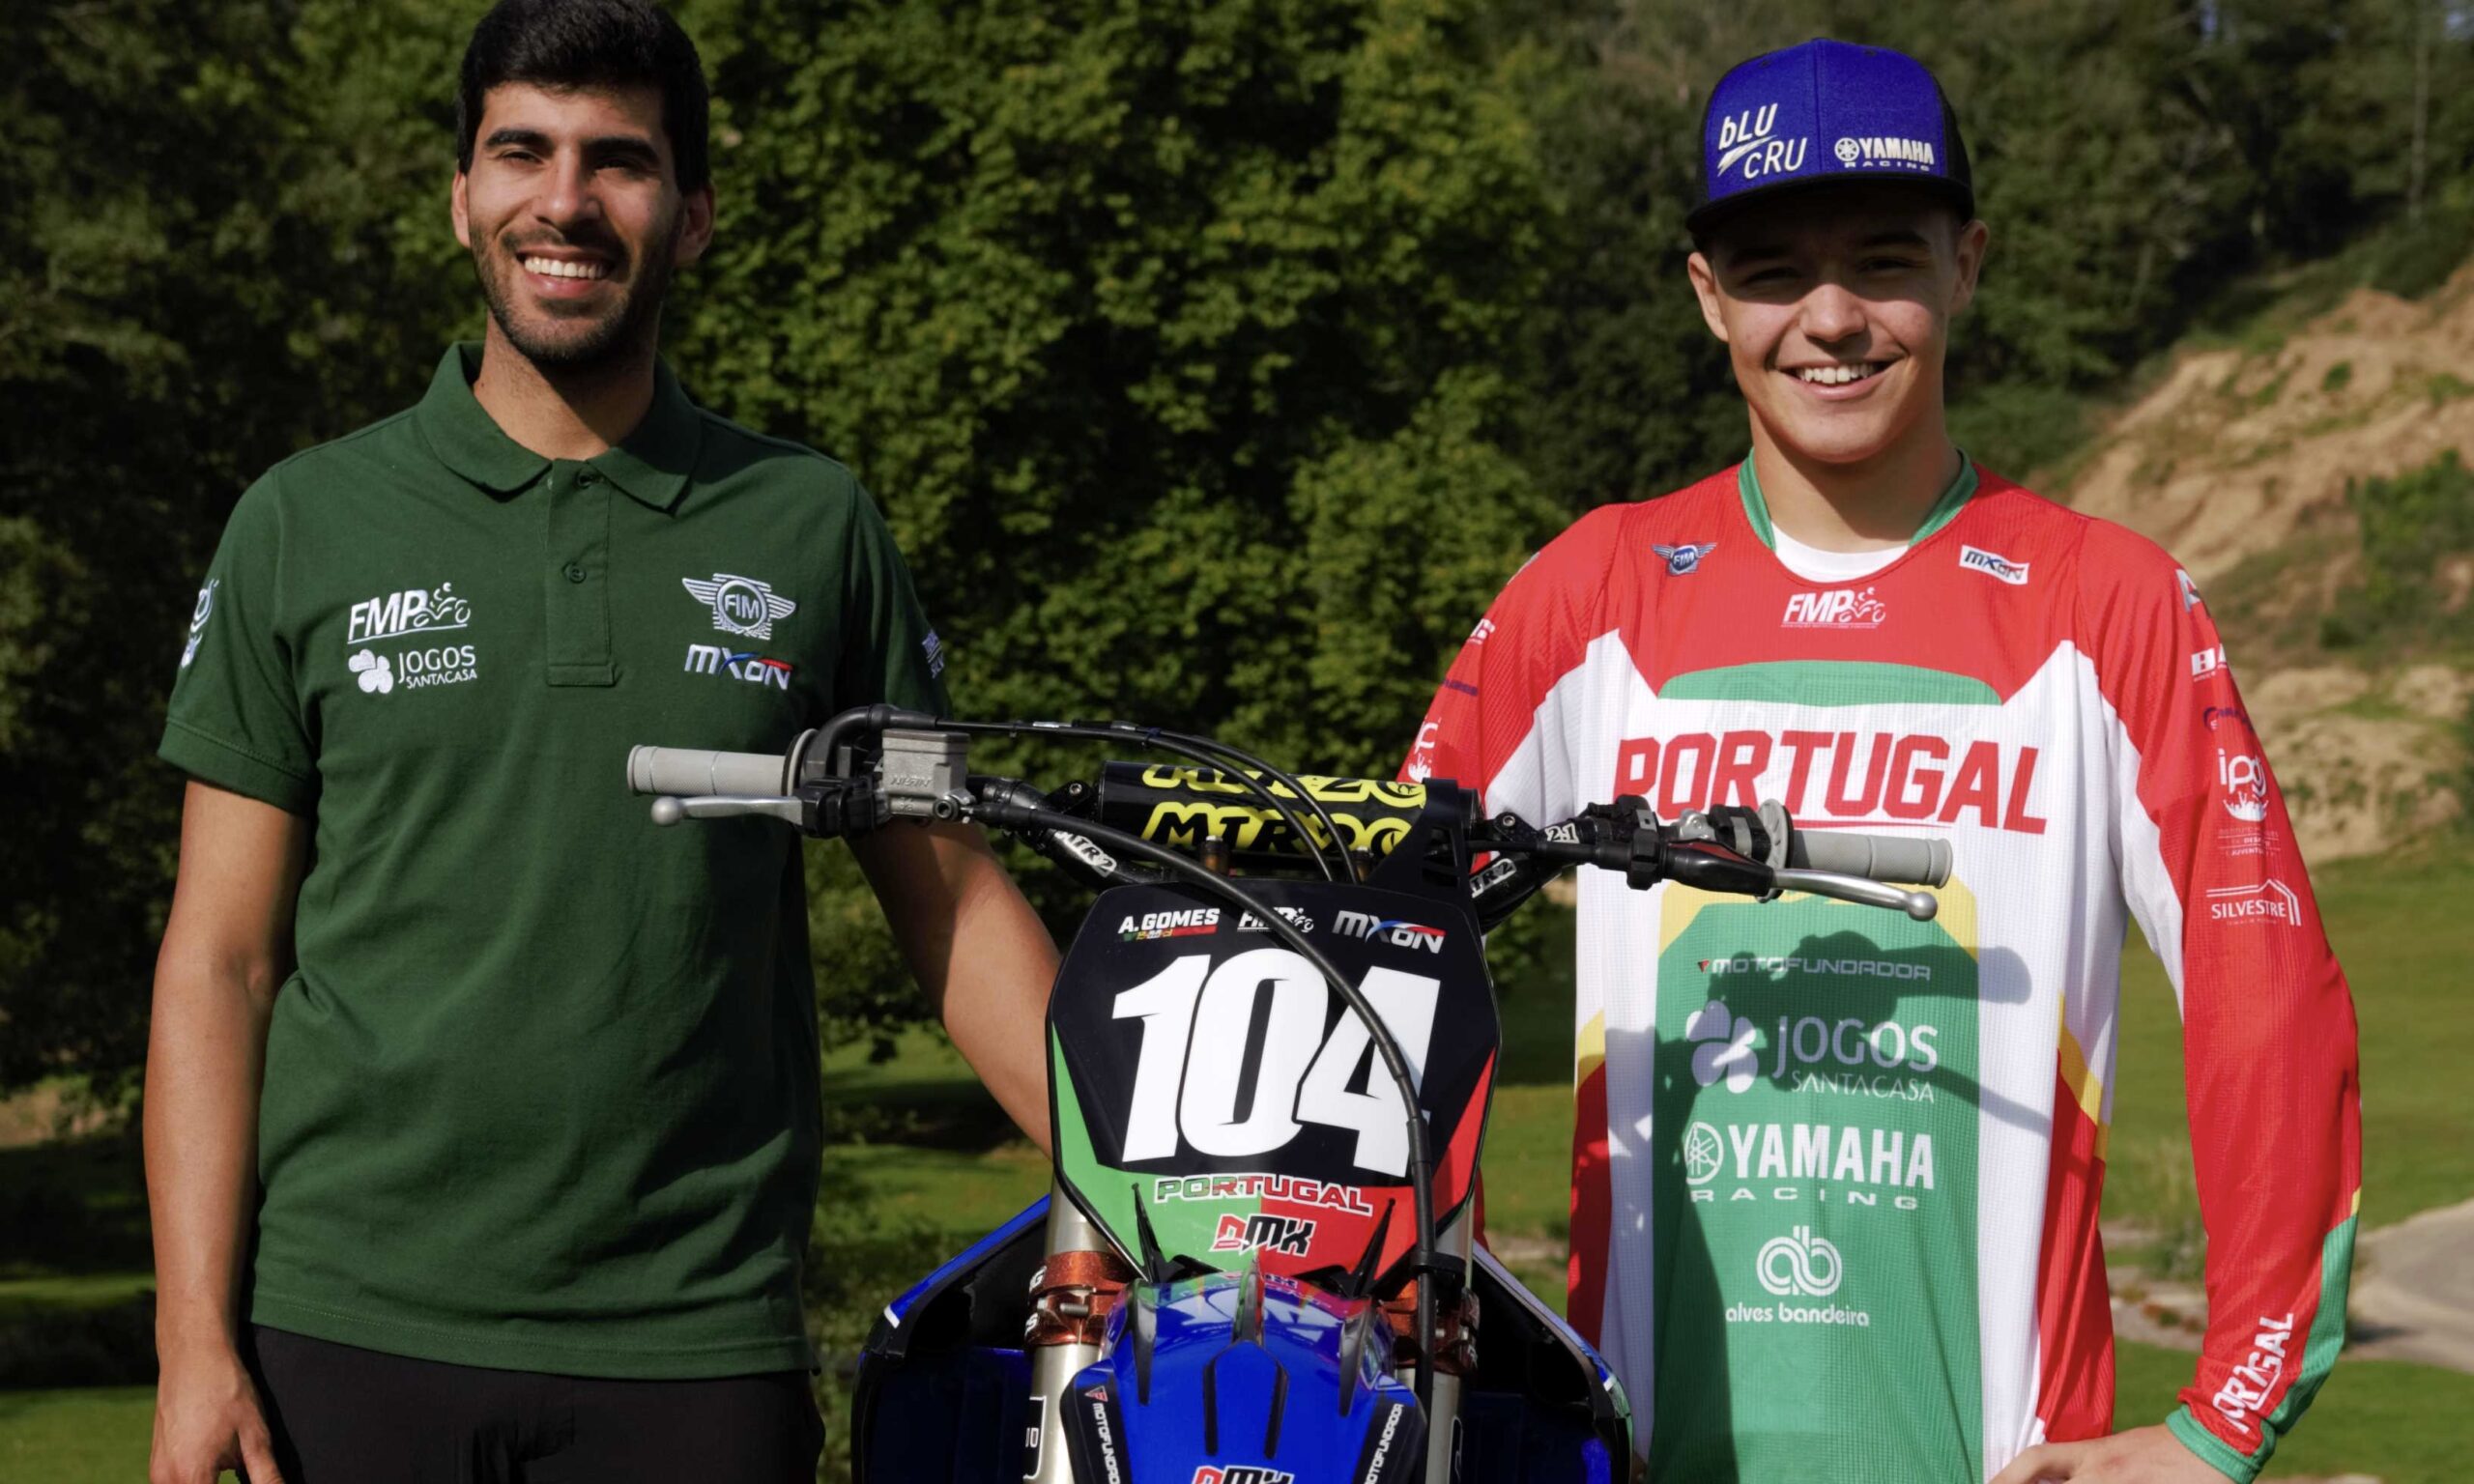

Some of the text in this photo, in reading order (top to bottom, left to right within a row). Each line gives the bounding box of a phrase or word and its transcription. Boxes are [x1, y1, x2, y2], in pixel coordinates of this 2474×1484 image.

[1858, 137, 1934, 164] YAMAHA
[1844, 160, 1930, 171] RACING
[1673, 552, 1696, 567] FIM
[348, 589, 428, 642] FMP
[724, 592, 761, 619] FIM
[1782, 589, 1856, 623] FMP
[397, 644, 476, 684] JOGOS
[405, 668, 478, 690] SANTACASA
[1613, 729, 2048, 835] PORTUGAL
[1117, 908, 1221, 934] A.GOMES
[2210, 899, 2287, 920] SILVESTRE
[1712, 956, 1932, 981] MOTOFUNDADOR
[1772, 1015, 1939, 1079] JOGOS
[1111, 948, 1441, 1178] 104
[1791, 1070, 1935, 1103] SANTACASA
[1728, 1123, 1934, 1190] YAMAHA
[1155, 1173, 1373, 1216] PORTUGAL
[1690, 1186, 1918, 1211] RACING
[1725, 1301, 1870, 1327] alves bandeira
